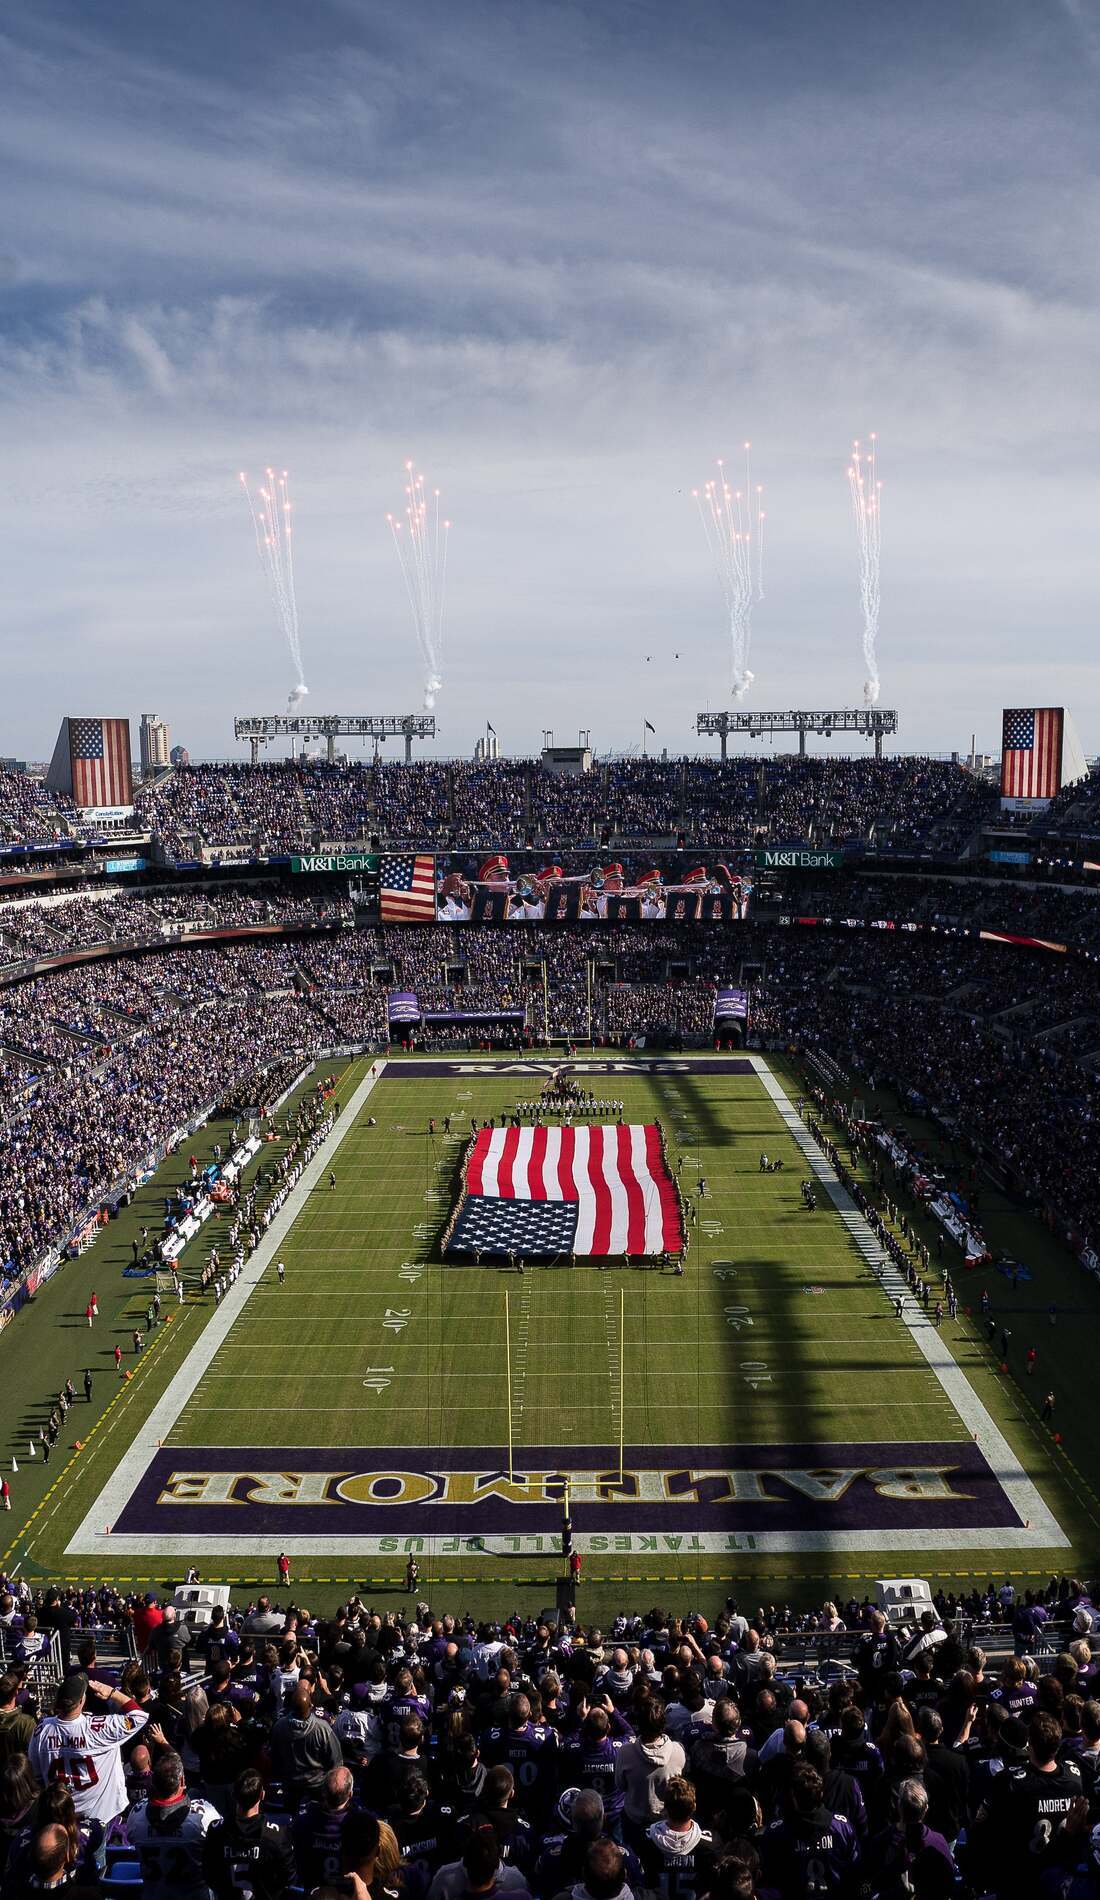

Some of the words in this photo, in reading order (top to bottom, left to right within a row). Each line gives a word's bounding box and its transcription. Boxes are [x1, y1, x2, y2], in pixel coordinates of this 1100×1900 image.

[300, 857, 336, 871] M&T
[336, 856, 370, 871] Bank
[764, 852, 800, 866] M&T
[800, 852, 834, 867] Bank
[449, 1063, 691, 1074] RAVENS
[398, 1262, 425, 1279] 30
[711, 1260, 737, 1276] 30
[383, 1308, 411, 1328] 20
[724, 1306, 753, 1325] 20
[363, 1366, 395, 1388] 10
[740, 1361, 772, 1382] 10
[156, 1465, 976, 1505] BALTIMORE
[378, 1537, 425, 1554] US
[504, 1536, 563, 1552] ALL
[589, 1535, 705, 1551] TAKES
[725, 1534, 757, 1551] IT
[1009, 1696, 1034, 1708] HUNTER
[393, 1706, 411, 1716] SMITH
[90, 1715, 107, 1733] 40
[48, 1735, 86, 1749] TILLMAN
[535, 1727, 545, 1741] 20
[49, 1754, 98, 1790] 40
[583, 1763, 614, 1773] JACKSON
[441, 1806, 452, 1814] 8
[1038, 1798, 1076, 1813] ANDREW
[266, 1821, 280, 1832] 5
